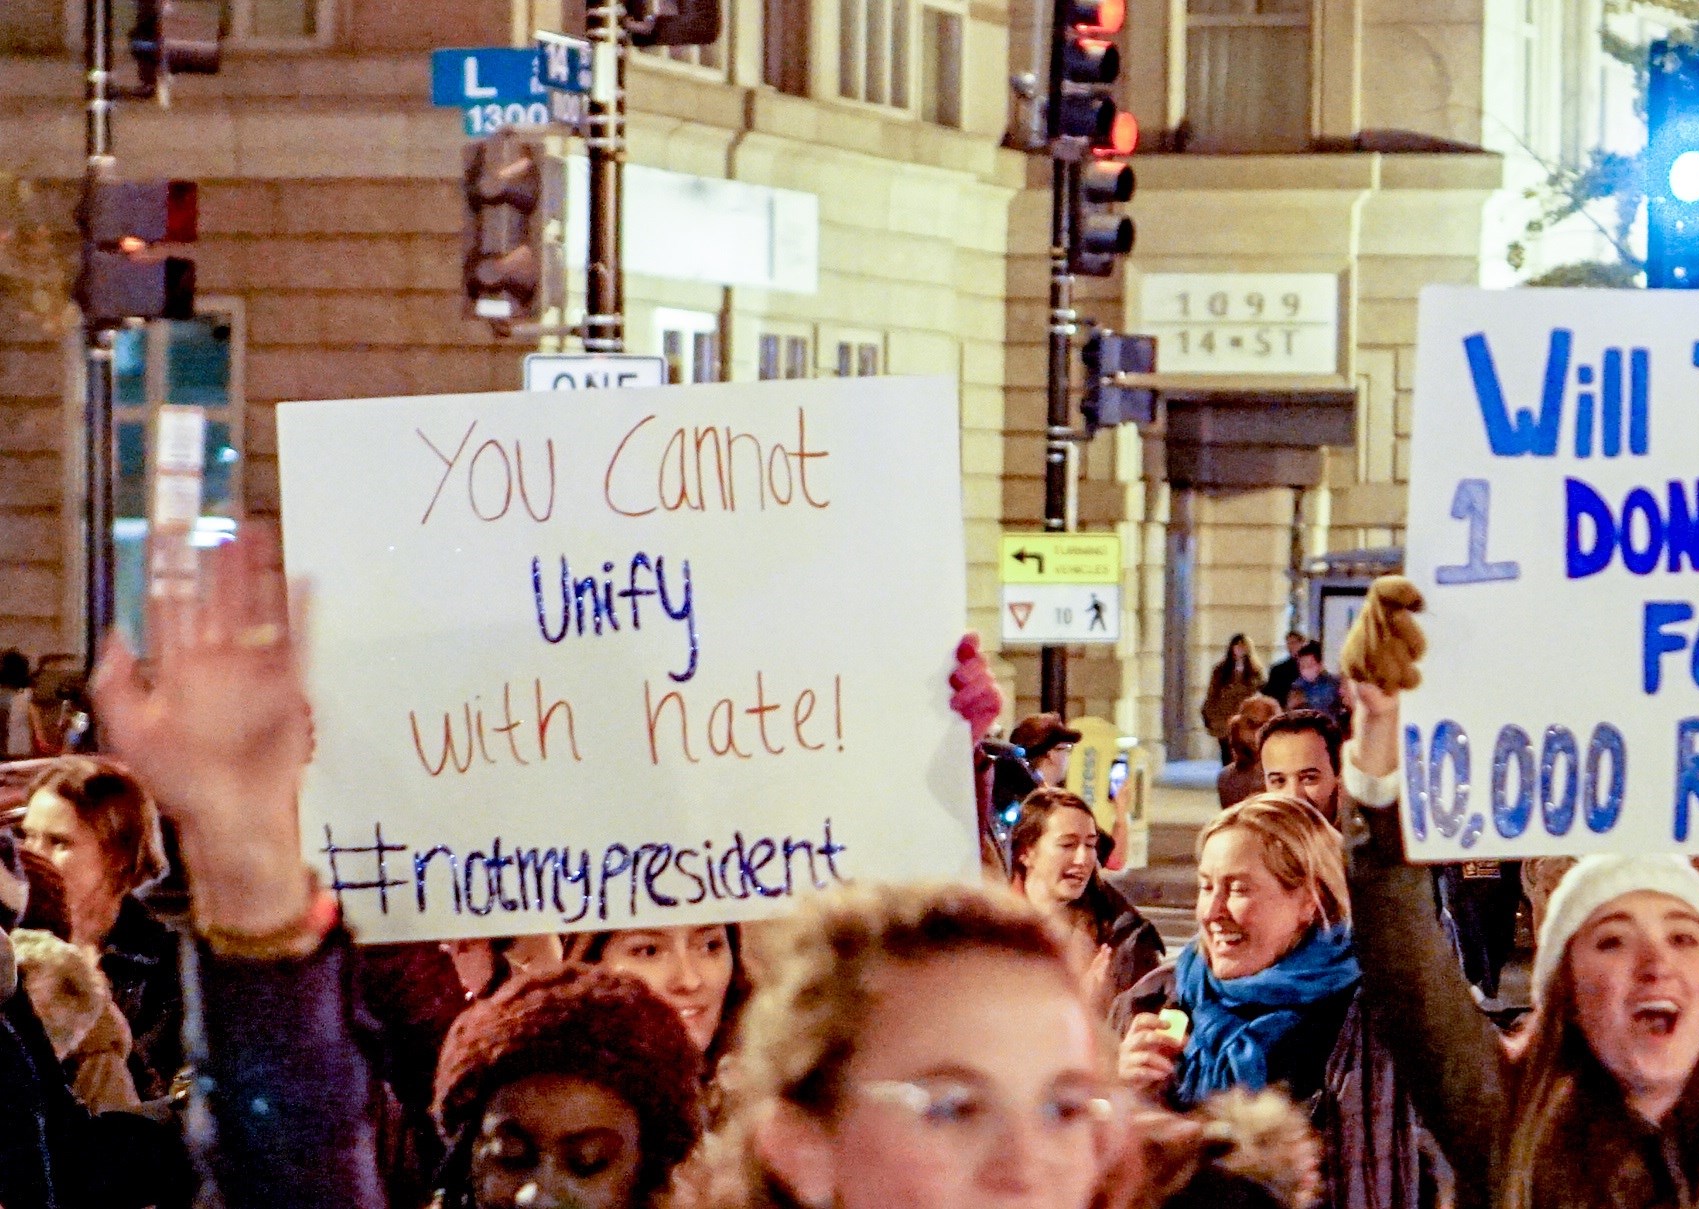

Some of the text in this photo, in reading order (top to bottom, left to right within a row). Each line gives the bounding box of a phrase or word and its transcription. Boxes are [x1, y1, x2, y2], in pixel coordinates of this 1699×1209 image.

[464, 56, 498, 99] L
[467, 102, 549, 133] 1300
[1176, 290, 1301, 317] 1099
[1462, 327, 1652, 459] Will
[602, 406, 831, 518] Cannot
[1434, 477, 1520, 585] 1
[531, 550, 700, 683] Unify
[409, 669, 847, 778] with hate!
[1403, 718, 1628, 850] 10,000
[319, 816, 854, 923] #notmypresident
